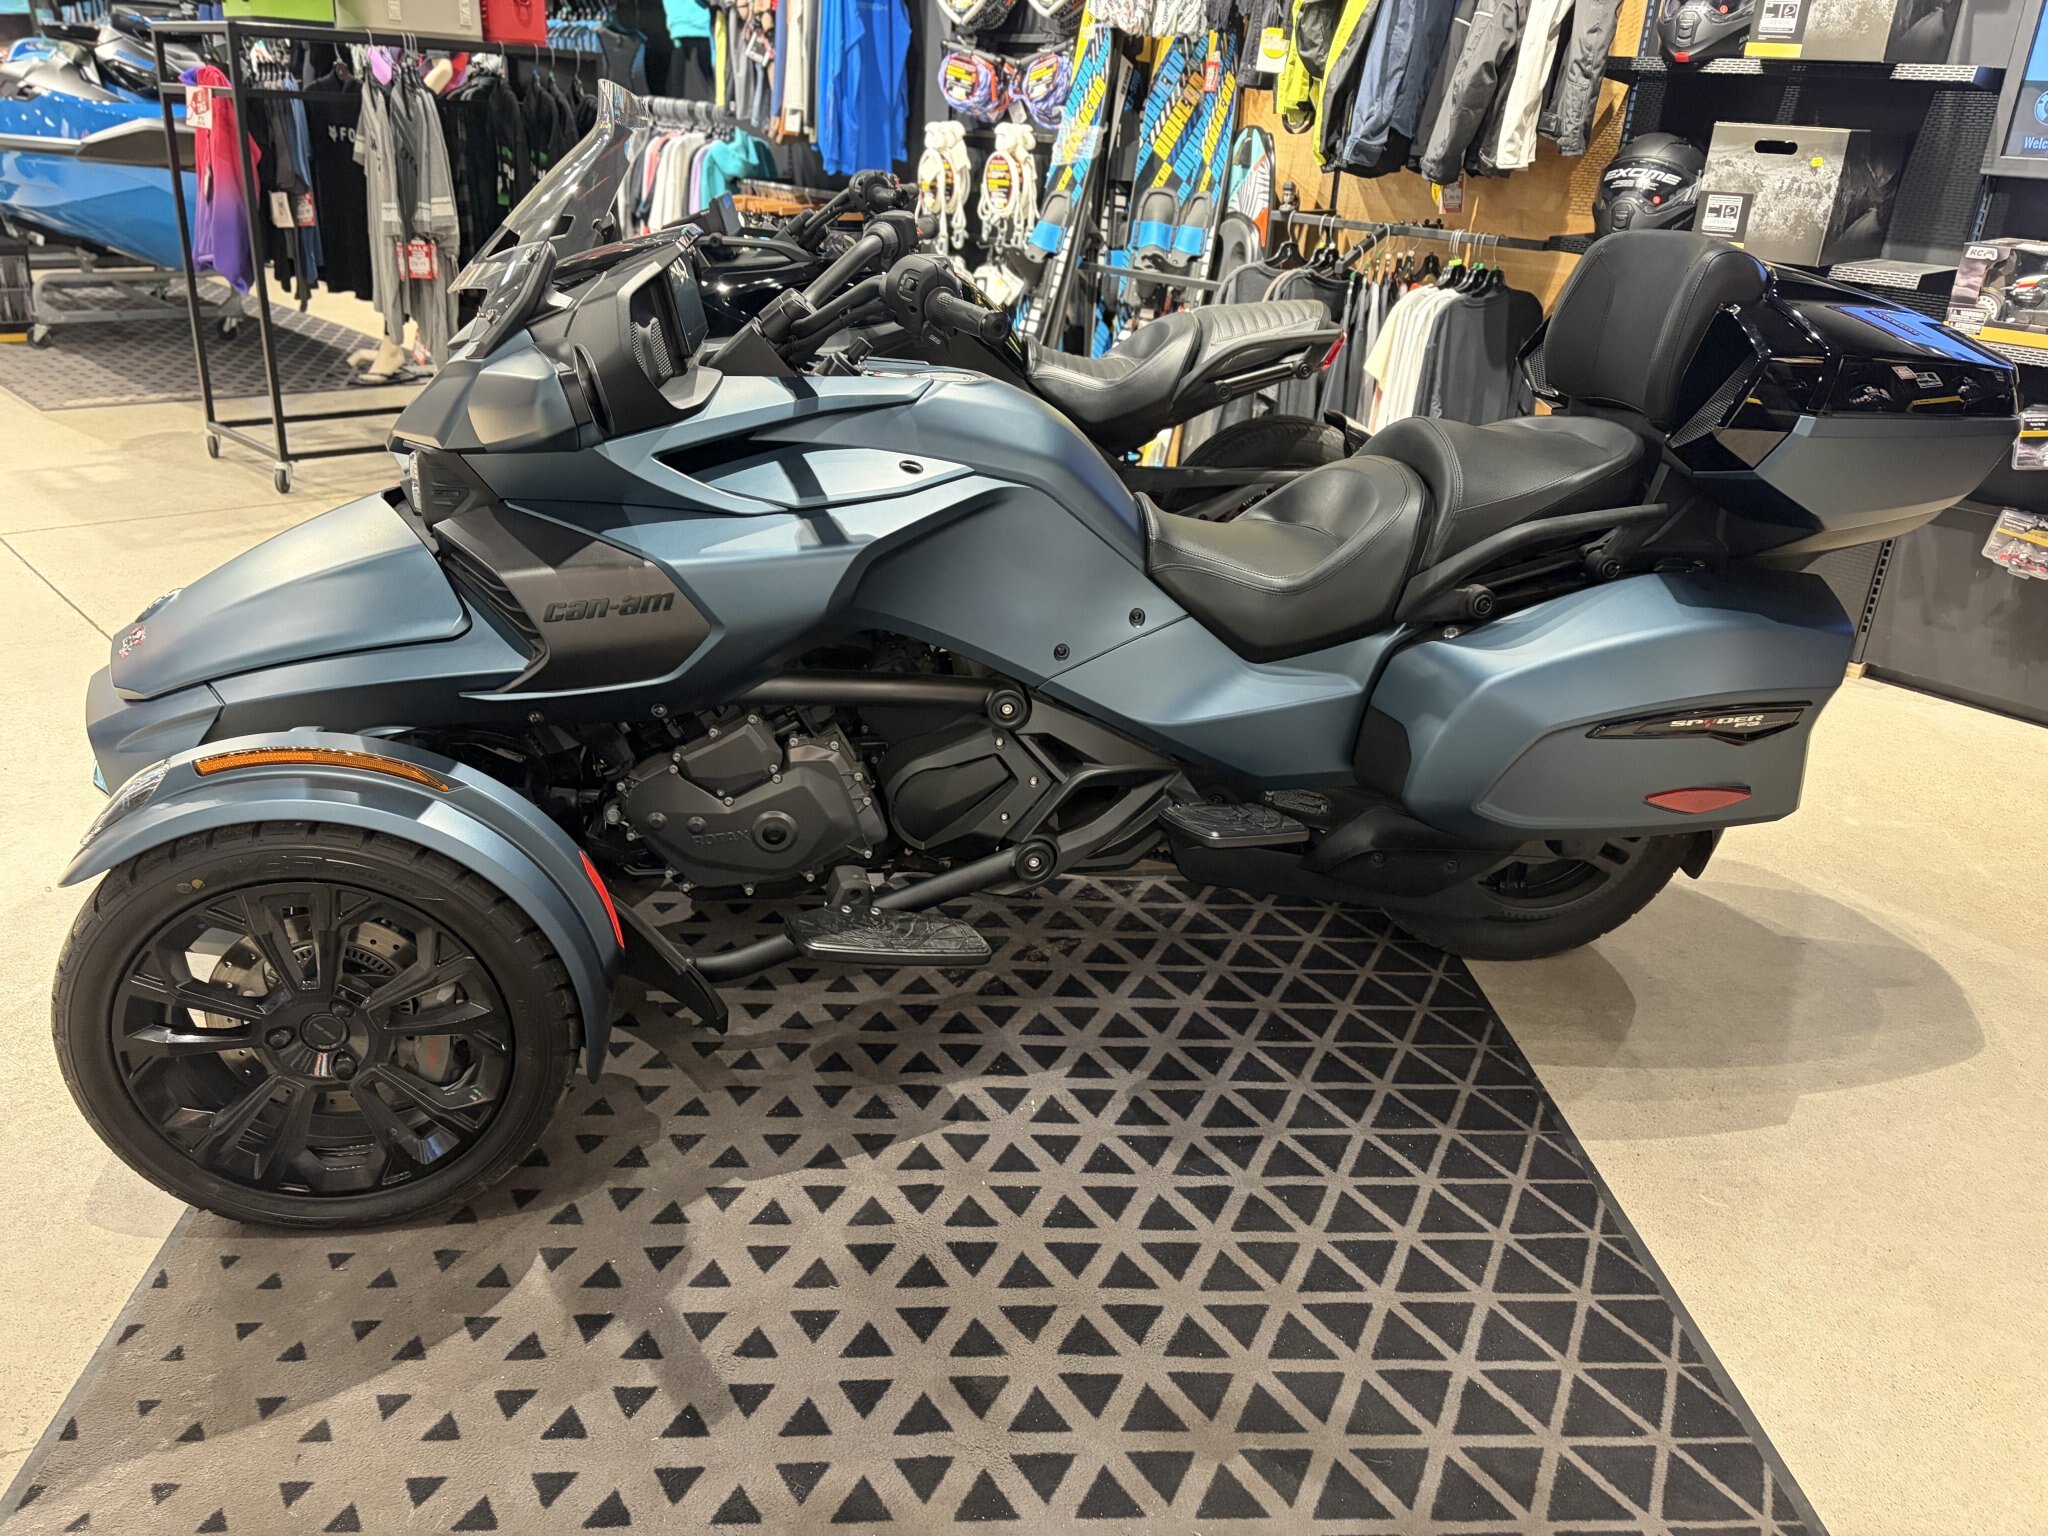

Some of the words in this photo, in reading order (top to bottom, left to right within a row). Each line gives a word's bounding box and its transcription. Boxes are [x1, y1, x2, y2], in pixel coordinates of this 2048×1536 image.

[1153, 72, 1206, 161] AIRHEAD
[1202, 71, 1236, 166] AIRHEAD
[1604, 167, 1682, 187] EXOME
[543, 592, 675, 623] can-am
[1669, 714, 1765, 730] SPYDER
[1733, 720, 1761, 728] F3
[690, 829, 751, 846] ROTAX
